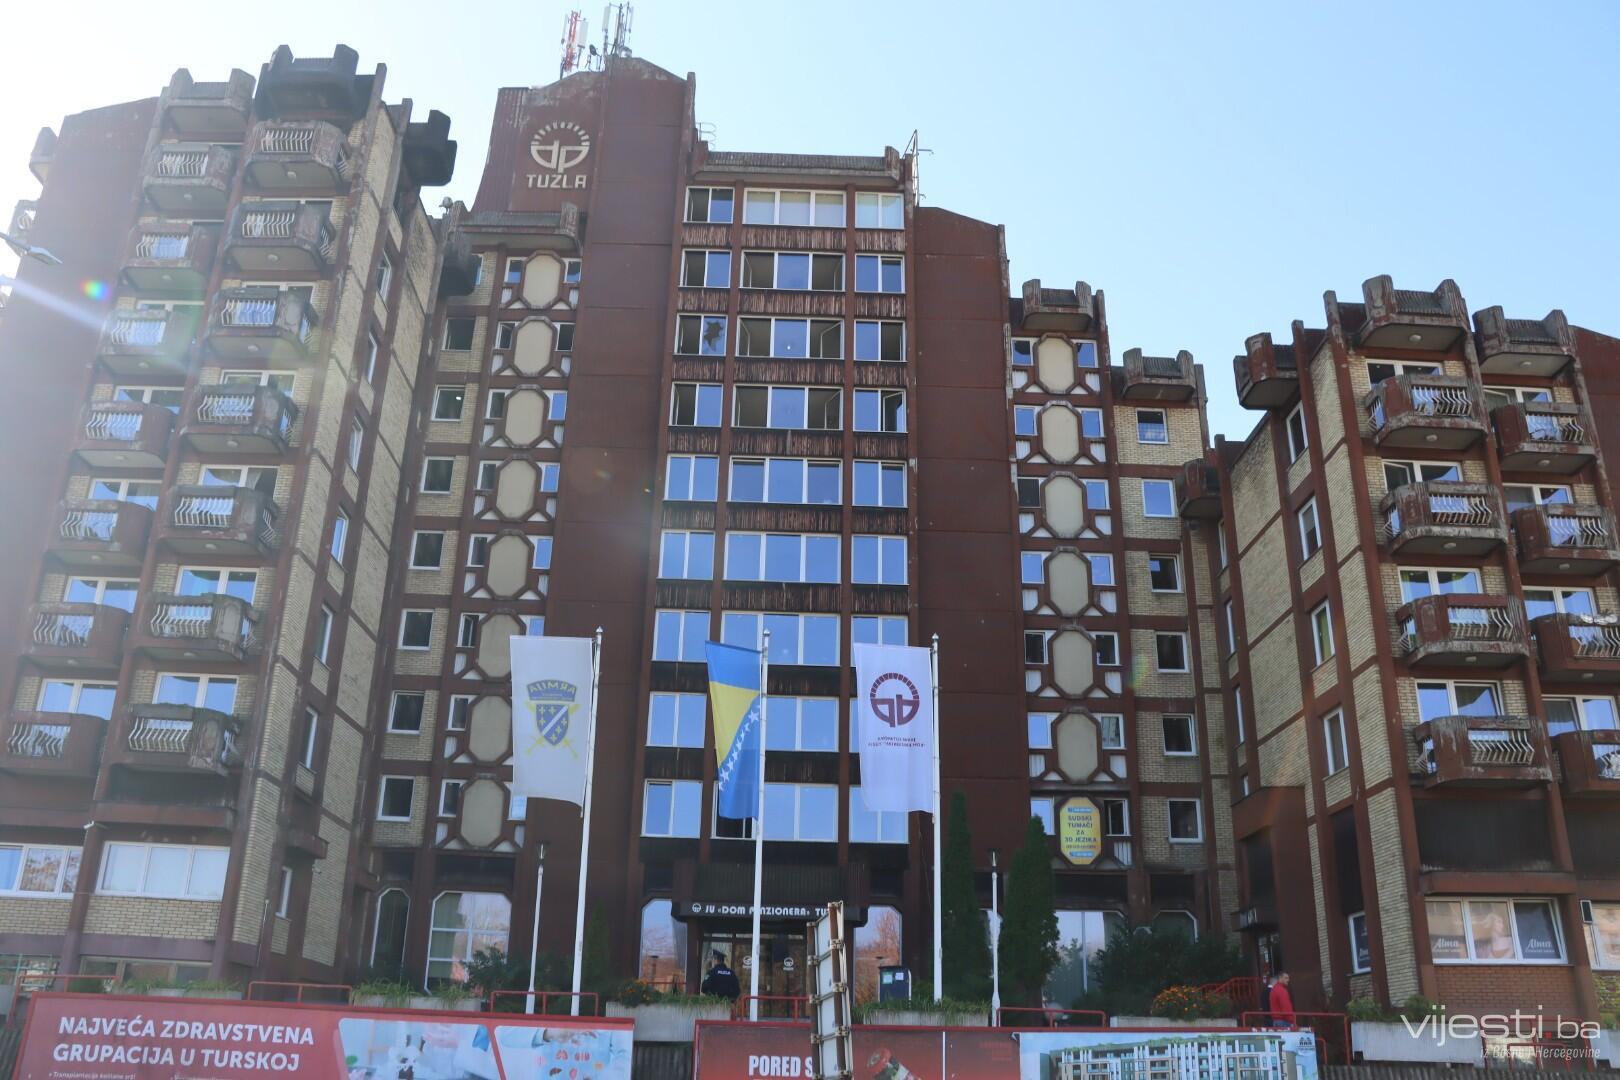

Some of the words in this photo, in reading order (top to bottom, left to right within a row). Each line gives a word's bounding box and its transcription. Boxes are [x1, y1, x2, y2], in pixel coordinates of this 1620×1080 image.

[526, 174, 587, 188] TUZLA
[705, 905, 715, 913] JU
[59, 1015, 156, 1038] NAJVEĆA
[160, 1020, 314, 1045] ZDRAVSTVENA
[53, 1043, 175, 1066] GRUPACIJA
[180, 1048, 195, 1066] U
[201, 1049, 299, 1072] TURSKOJ
[748, 1055, 801, 1077] PORED
[805, 1056, 813, 1077] S
